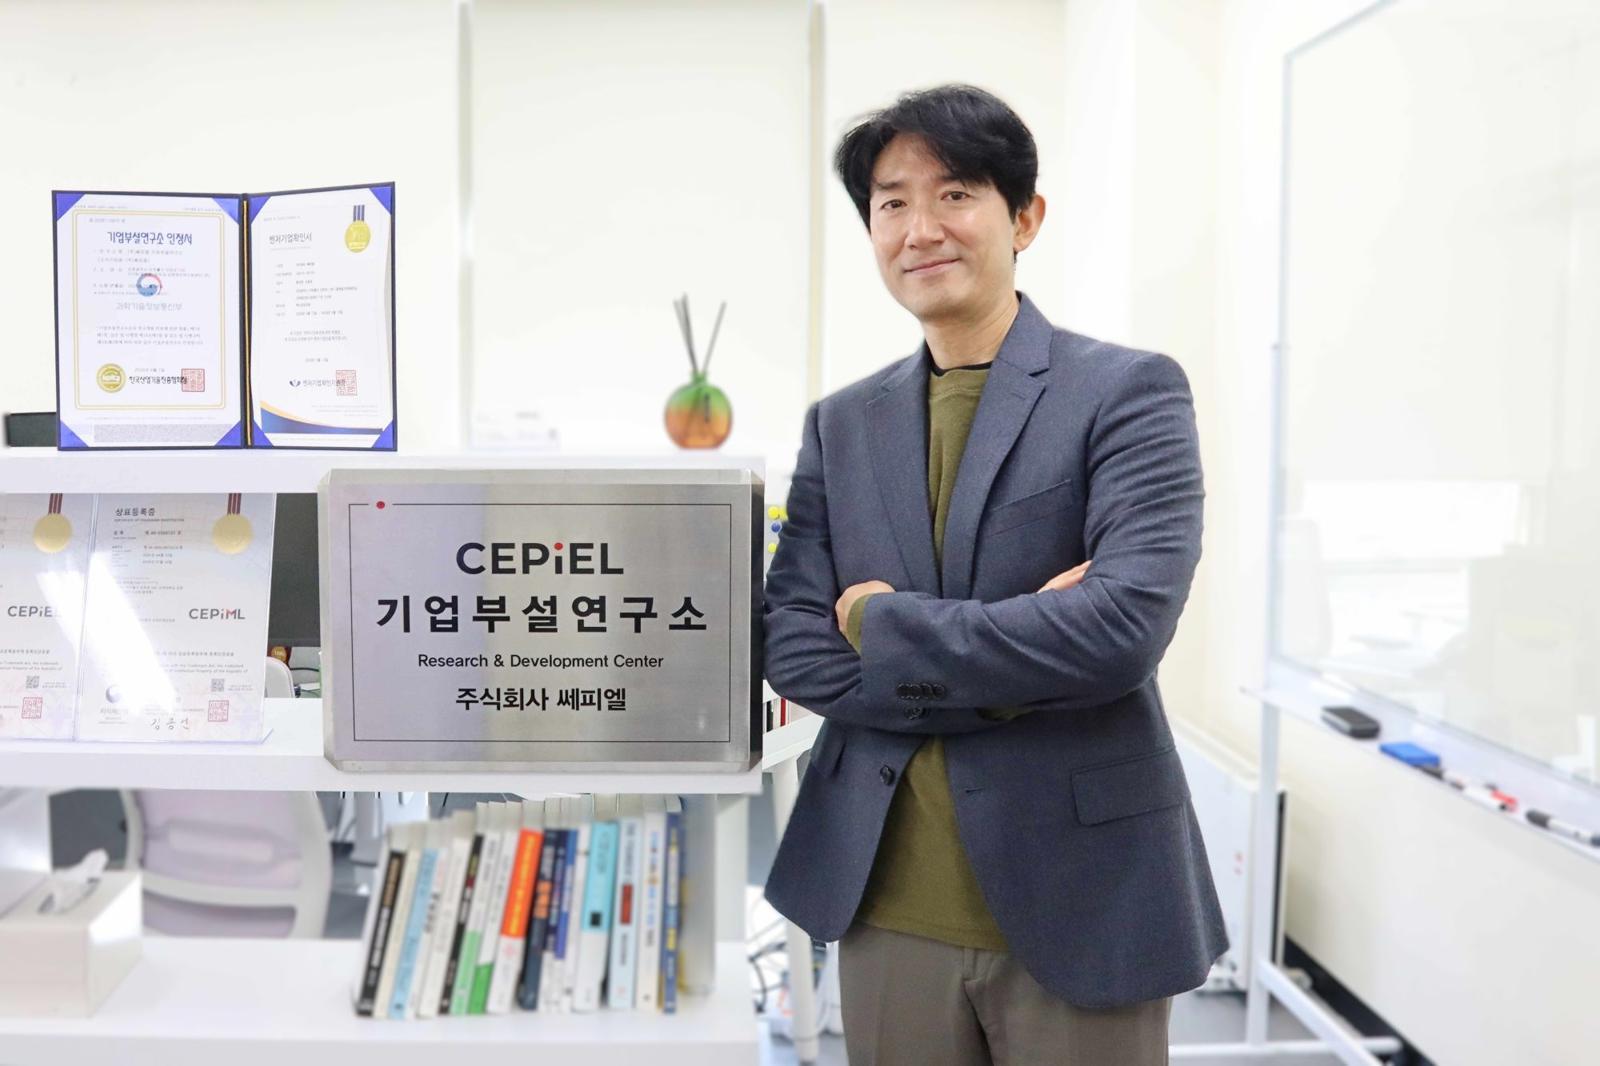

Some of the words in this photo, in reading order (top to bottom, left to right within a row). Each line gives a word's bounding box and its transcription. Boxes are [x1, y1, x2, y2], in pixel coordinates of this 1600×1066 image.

[107, 231, 163, 245] 기업부설연구소
[167, 233, 192, 246] 인정서
[115, 508, 156, 517] 상표등록증
[7, 605, 62, 618] CEPiE
[376, 595, 707, 633] 기업부설연구소
[418, 654, 488, 668] Research
[494, 654, 504, 668] &
[510, 654, 608, 670] Development
[614, 654, 664, 668] Center
[456, 688, 549, 711] 주식회사
[557, 687, 627, 711] 쎄피엘
